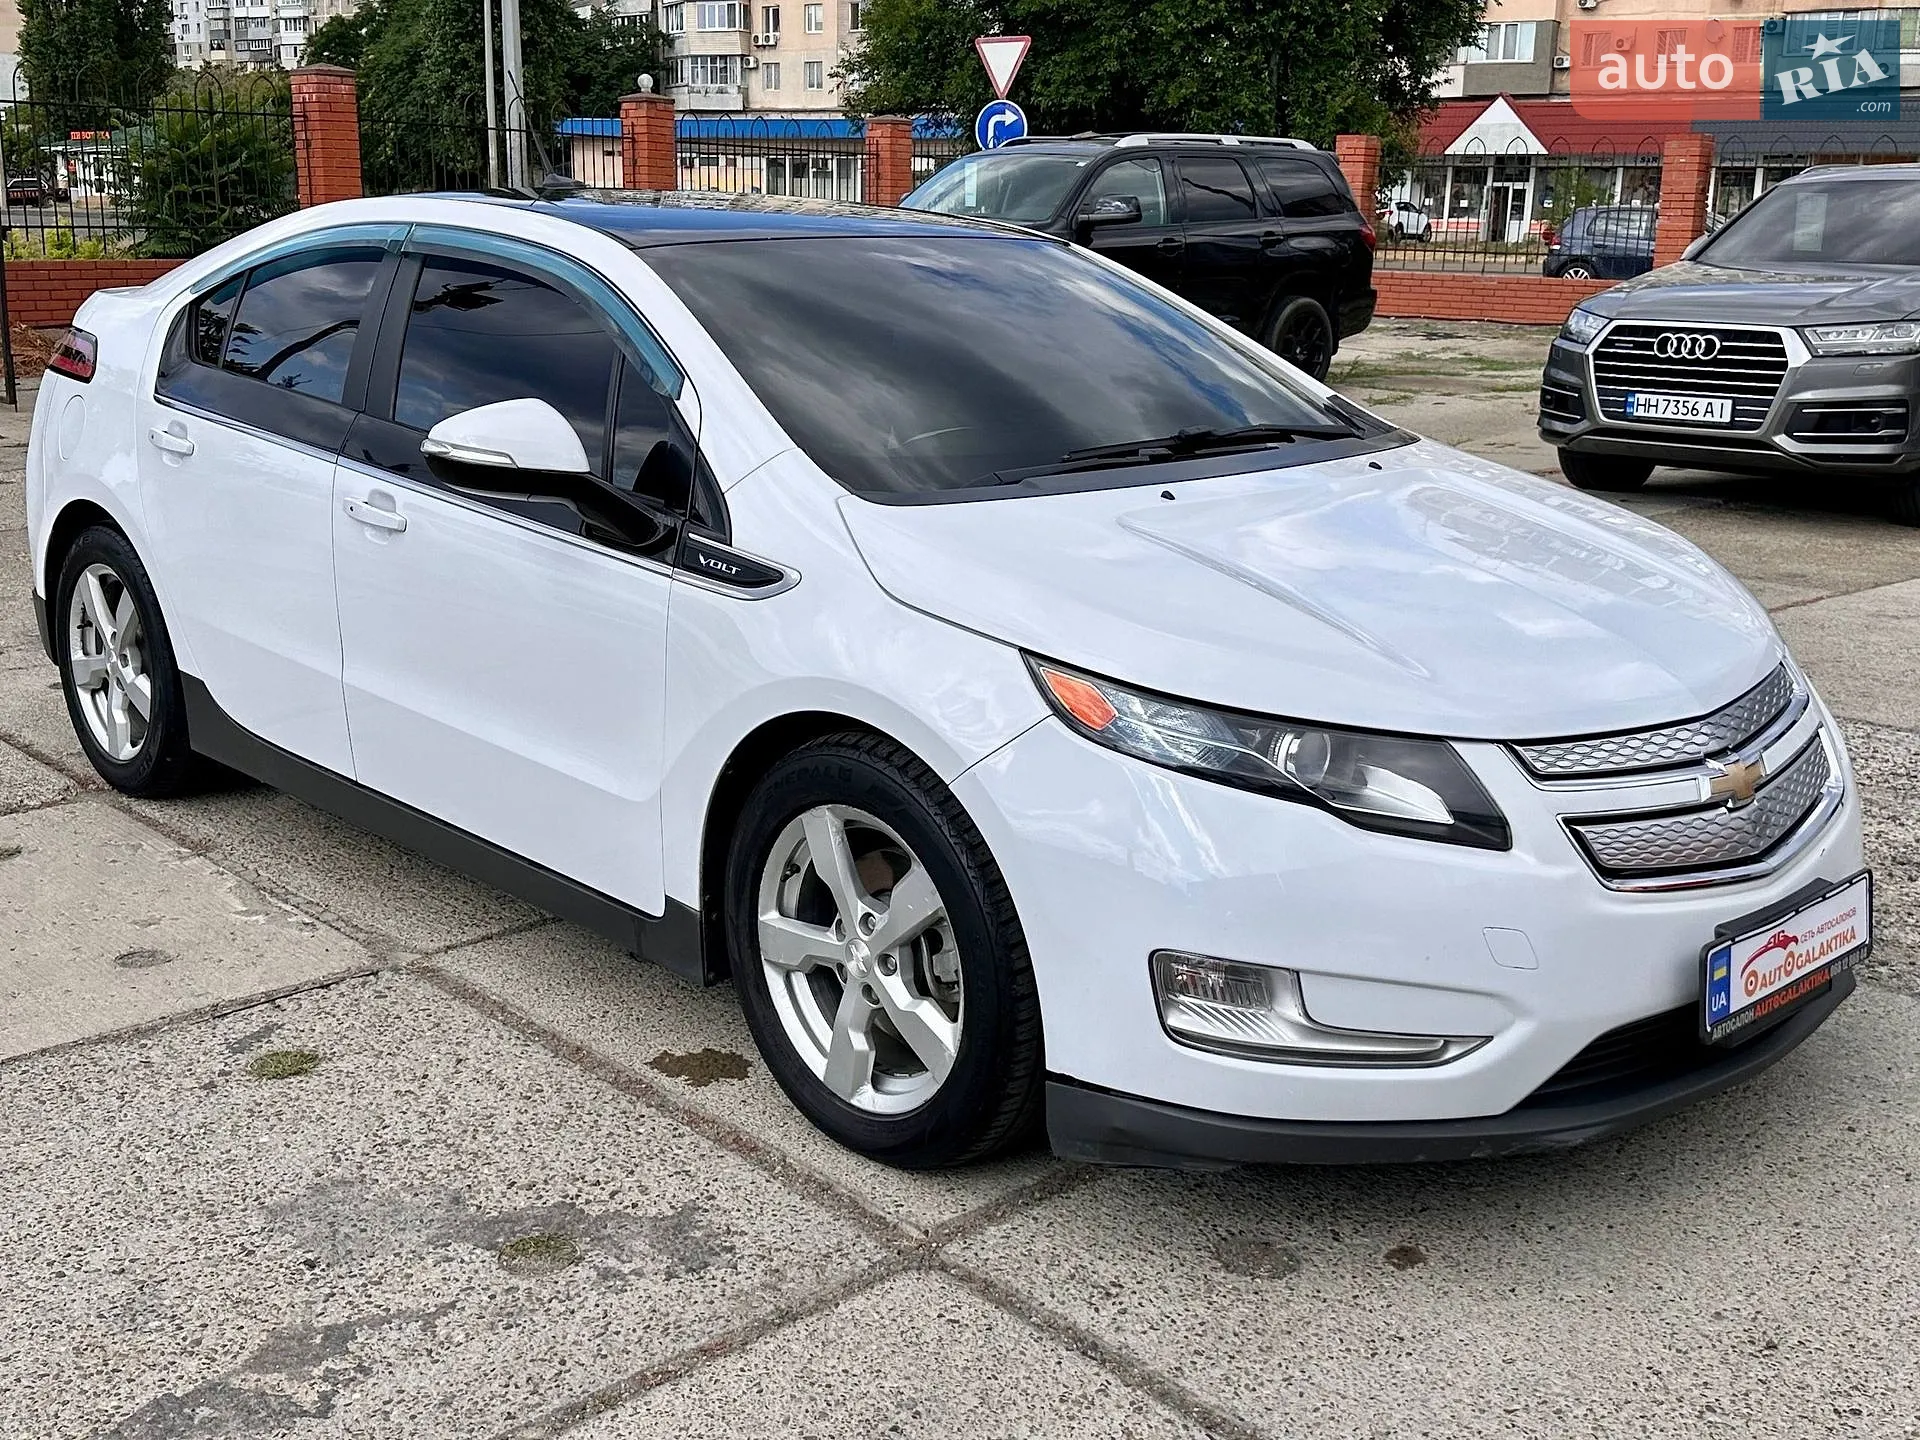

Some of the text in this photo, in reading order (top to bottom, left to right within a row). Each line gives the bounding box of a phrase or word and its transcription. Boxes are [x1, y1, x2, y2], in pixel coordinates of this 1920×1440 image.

[71, 131, 110, 140] ПИВОТКА
[698, 552, 742, 575] VOLT
[1800, 932, 1816, 944] СЕТЬ
[1816, 906, 1857, 935] АВТОСАЛОНОВ
[1711, 991, 1727, 1012] UA
[1711, 967, 1830, 1041] АВТОСАЛОН AUTOGALAKTIKA
